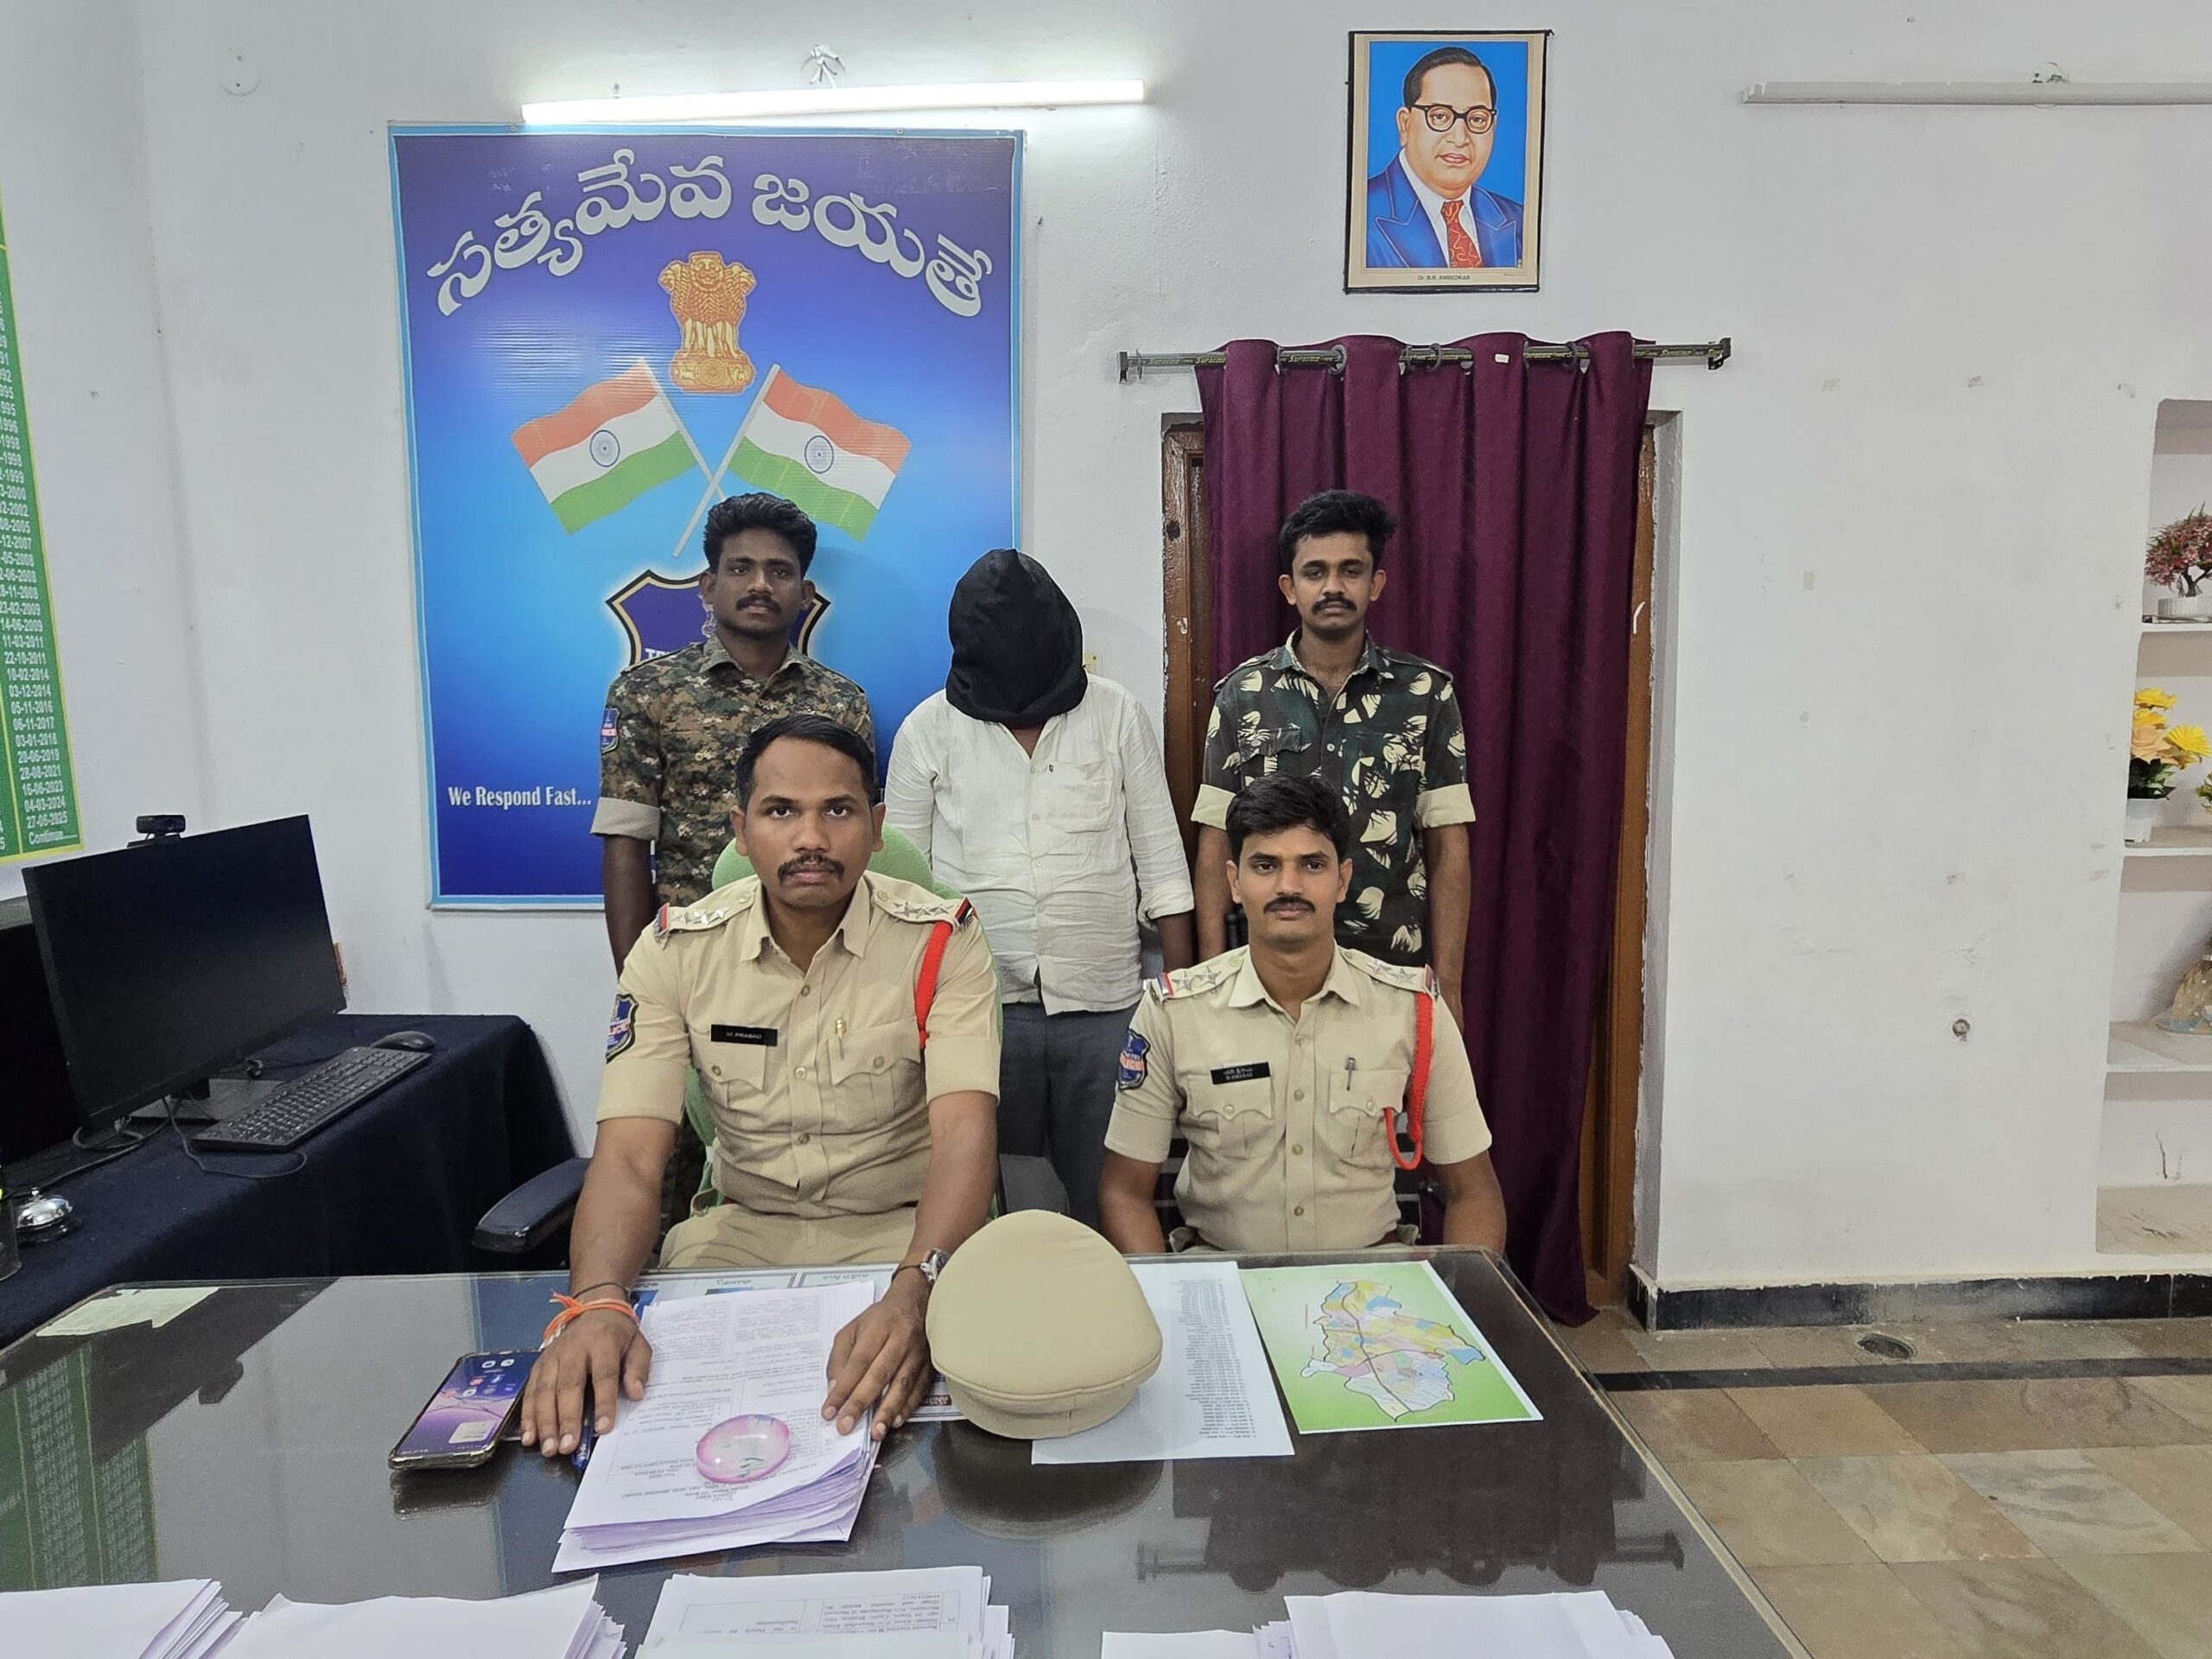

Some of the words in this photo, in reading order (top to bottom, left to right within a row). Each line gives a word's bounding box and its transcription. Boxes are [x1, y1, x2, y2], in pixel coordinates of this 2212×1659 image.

[426, 148, 733, 316] సత్యమేవ
[752, 171, 995, 318] జయతే
[448, 786, 471, 806] We
[475, 785, 541, 810] Respond
[545, 785, 592, 806] Fast...
